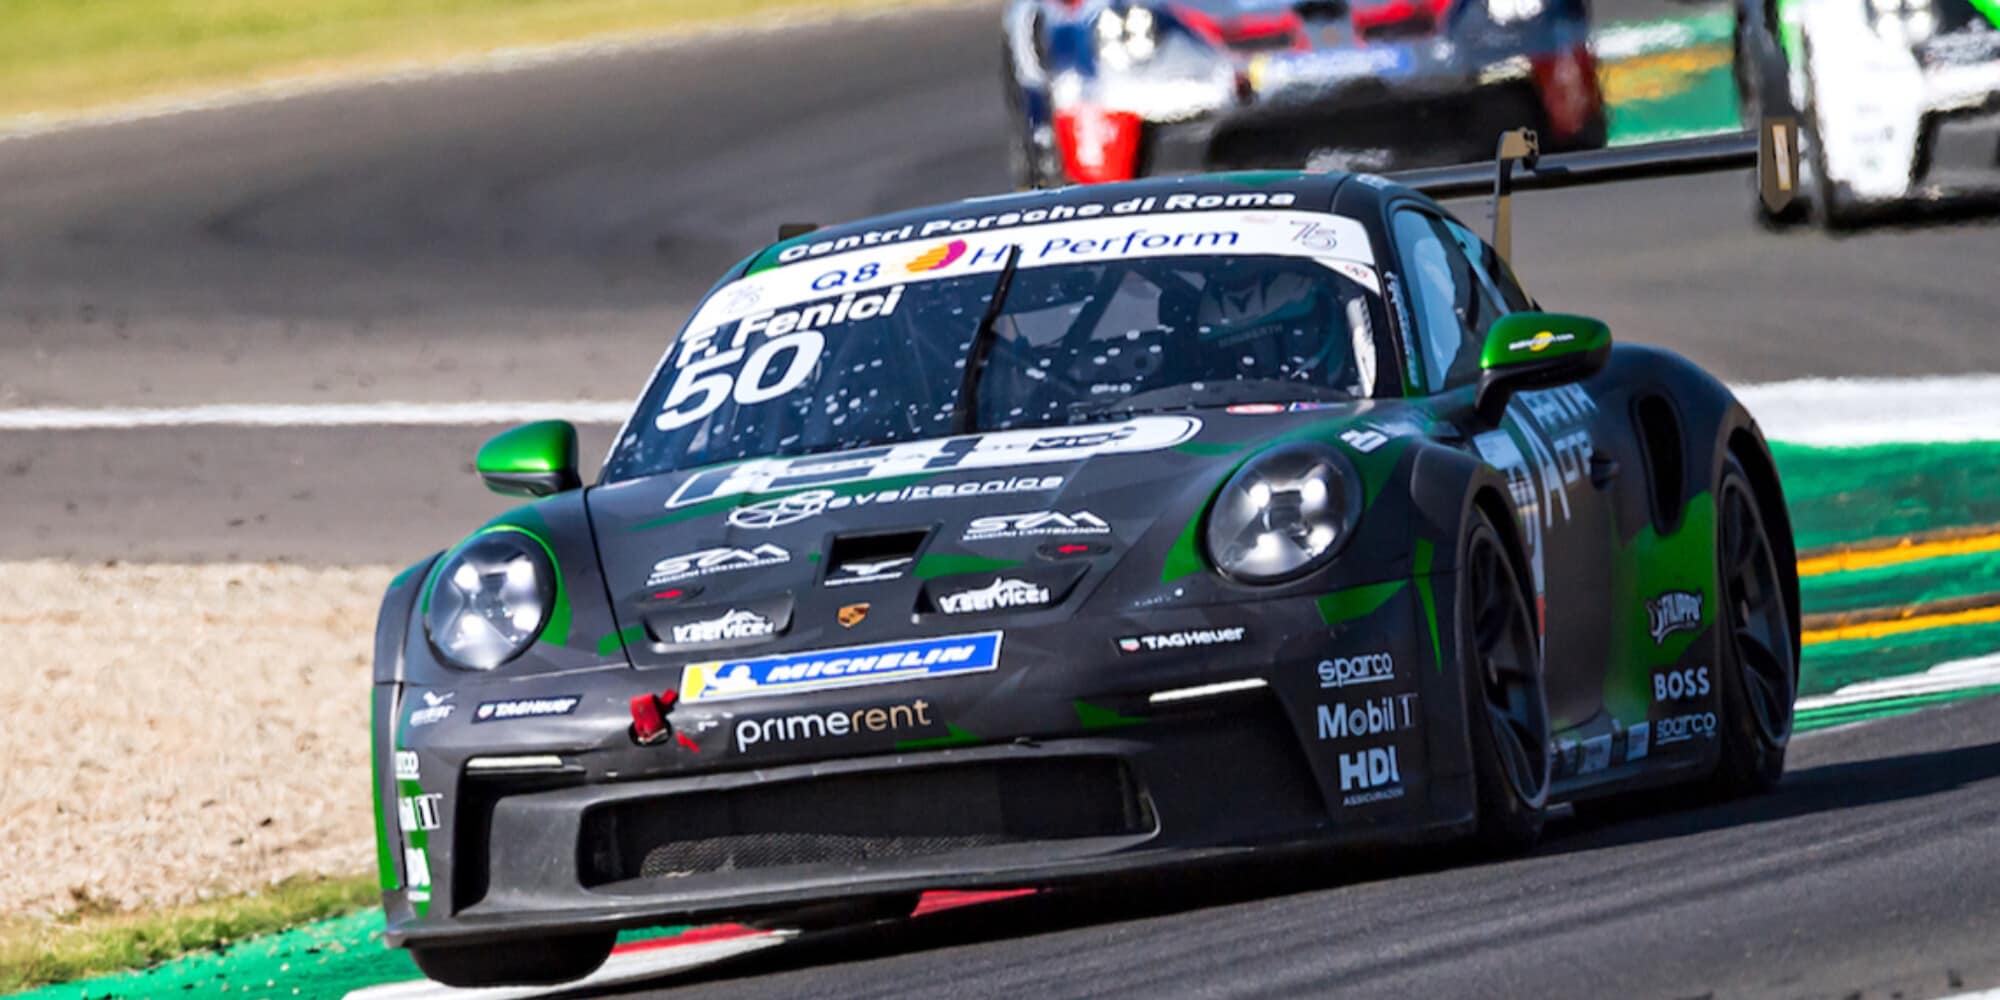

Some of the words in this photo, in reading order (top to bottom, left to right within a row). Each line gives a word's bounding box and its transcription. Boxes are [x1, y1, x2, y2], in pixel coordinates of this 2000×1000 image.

[778, 225, 913, 263] Centri
[920, 204, 1112, 236] Porsche
[1113, 196, 1156, 214] di
[1164, 192, 1297, 210] Roma
[811, 262, 881, 290] Q8
[1039, 229, 1240, 259] Perform
[676, 328, 718, 368] F.
[731, 285, 906, 348] Fenici
[655, 330, 825, 431] 50
[766, 645, 976, 682] MICHELIN
[1317, 653, 1394, 688] sparco
[1654, 666, 1711, 701] BOSS
[736, 700, 932, 752] primerent
[1317, 696, 1396, 740] Mobil
[1656, 712, 1717, 745] sparco
[1339, 745, 1400, 791] HDI
